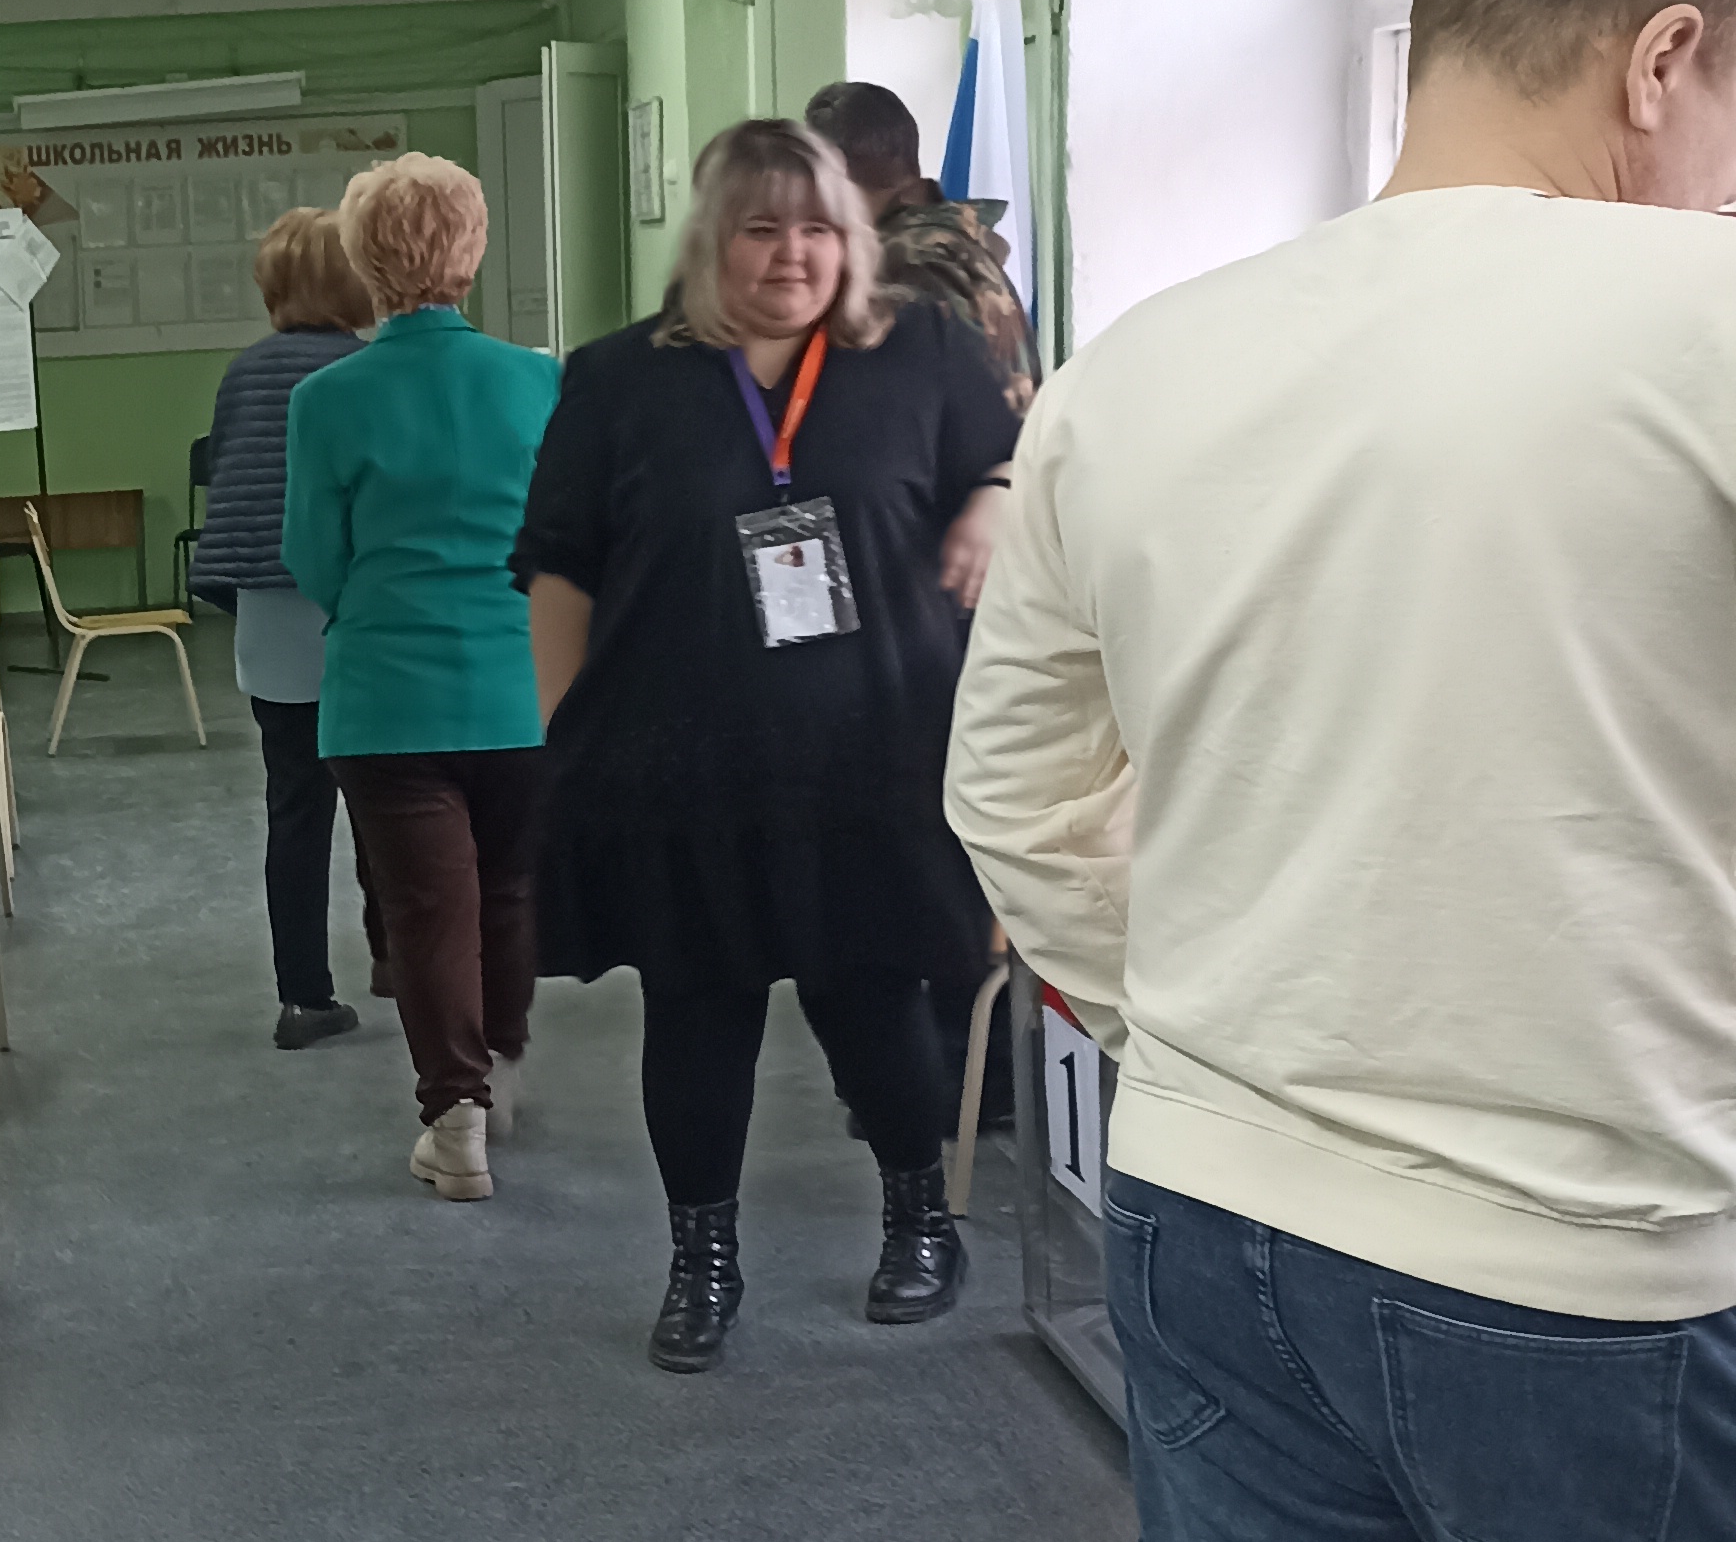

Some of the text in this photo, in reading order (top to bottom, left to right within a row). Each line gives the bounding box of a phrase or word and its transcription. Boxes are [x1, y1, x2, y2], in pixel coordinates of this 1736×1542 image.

[27, 131, 293, 168] ШКОЛЬНАЯ ЖИЗНЬ
[1059, 1050, 1086, 1183] 1
